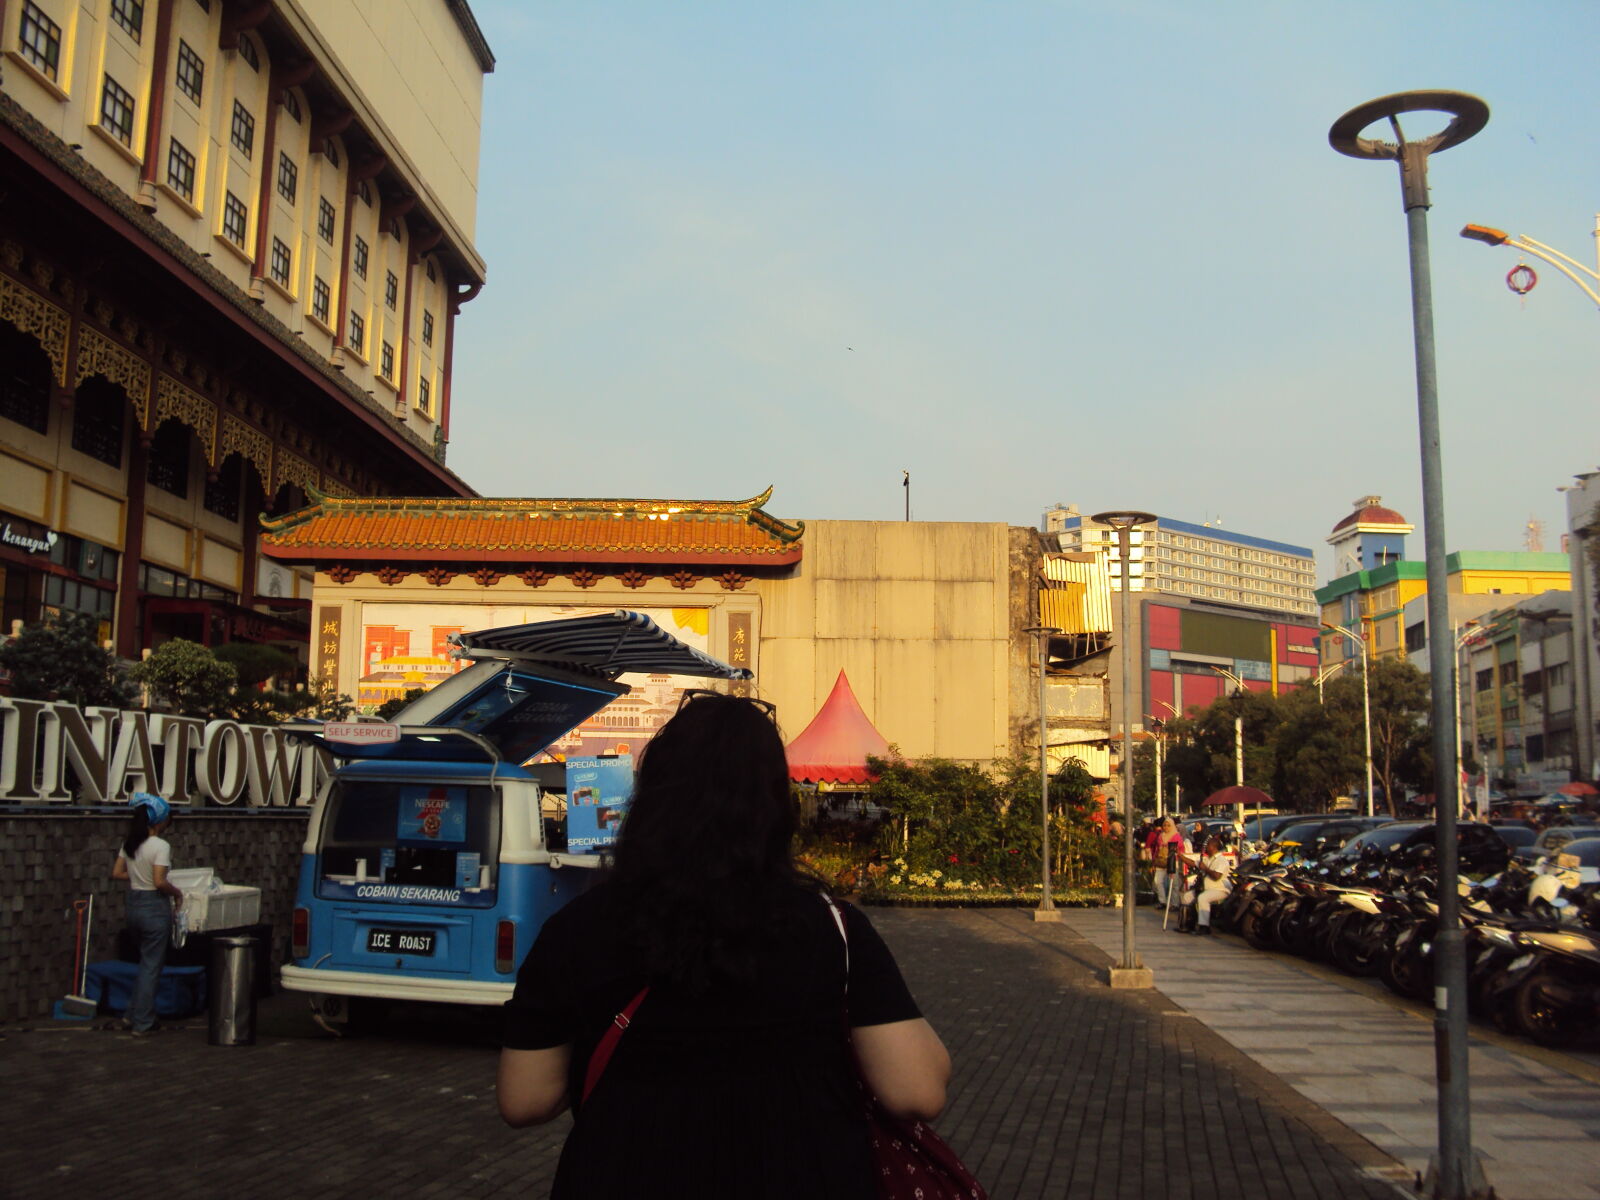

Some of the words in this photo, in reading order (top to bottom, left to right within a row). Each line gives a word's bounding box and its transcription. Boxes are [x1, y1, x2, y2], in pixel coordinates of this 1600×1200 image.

[328, 727, 351, 737] SELF
[353, 728, 393, 738] SERVICE
[566, 760, 600, 769] SPECIAL
[567, 837, 601, 847] SPECIAL
[357, 885, 399, 899] COBAIN
[400, 887, 460, 902] SEKARANG
[371, 933, 391, 948] ICE
[399, 936, 432, 951] ROAST
